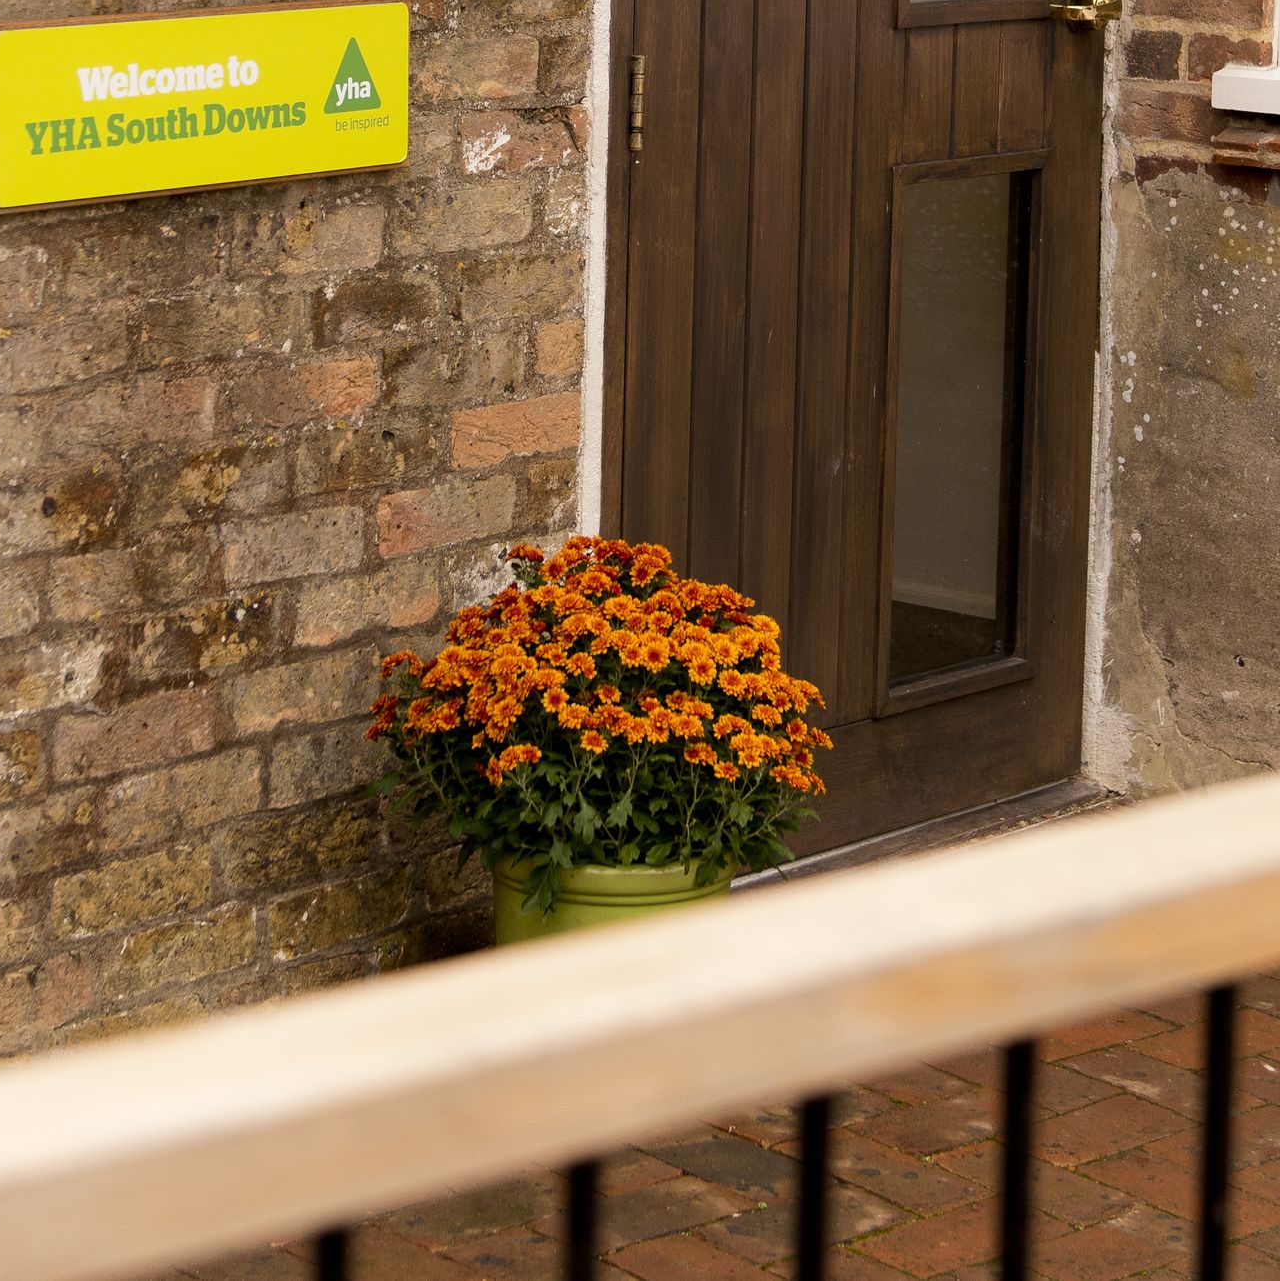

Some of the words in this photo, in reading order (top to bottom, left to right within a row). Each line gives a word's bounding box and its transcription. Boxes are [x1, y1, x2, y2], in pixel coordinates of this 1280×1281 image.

[77, 62, 224, 103] Welcome
[227, 55, 260, 87] to
[335, 75, 372, 107] yha
[25, 116, 102, 156] YHA
[106, 105, 199, 147] South
[203, 100, 306, 137] Downs
[334, 118, 349, 132] be
[349, 113, 390, 134] inspired
